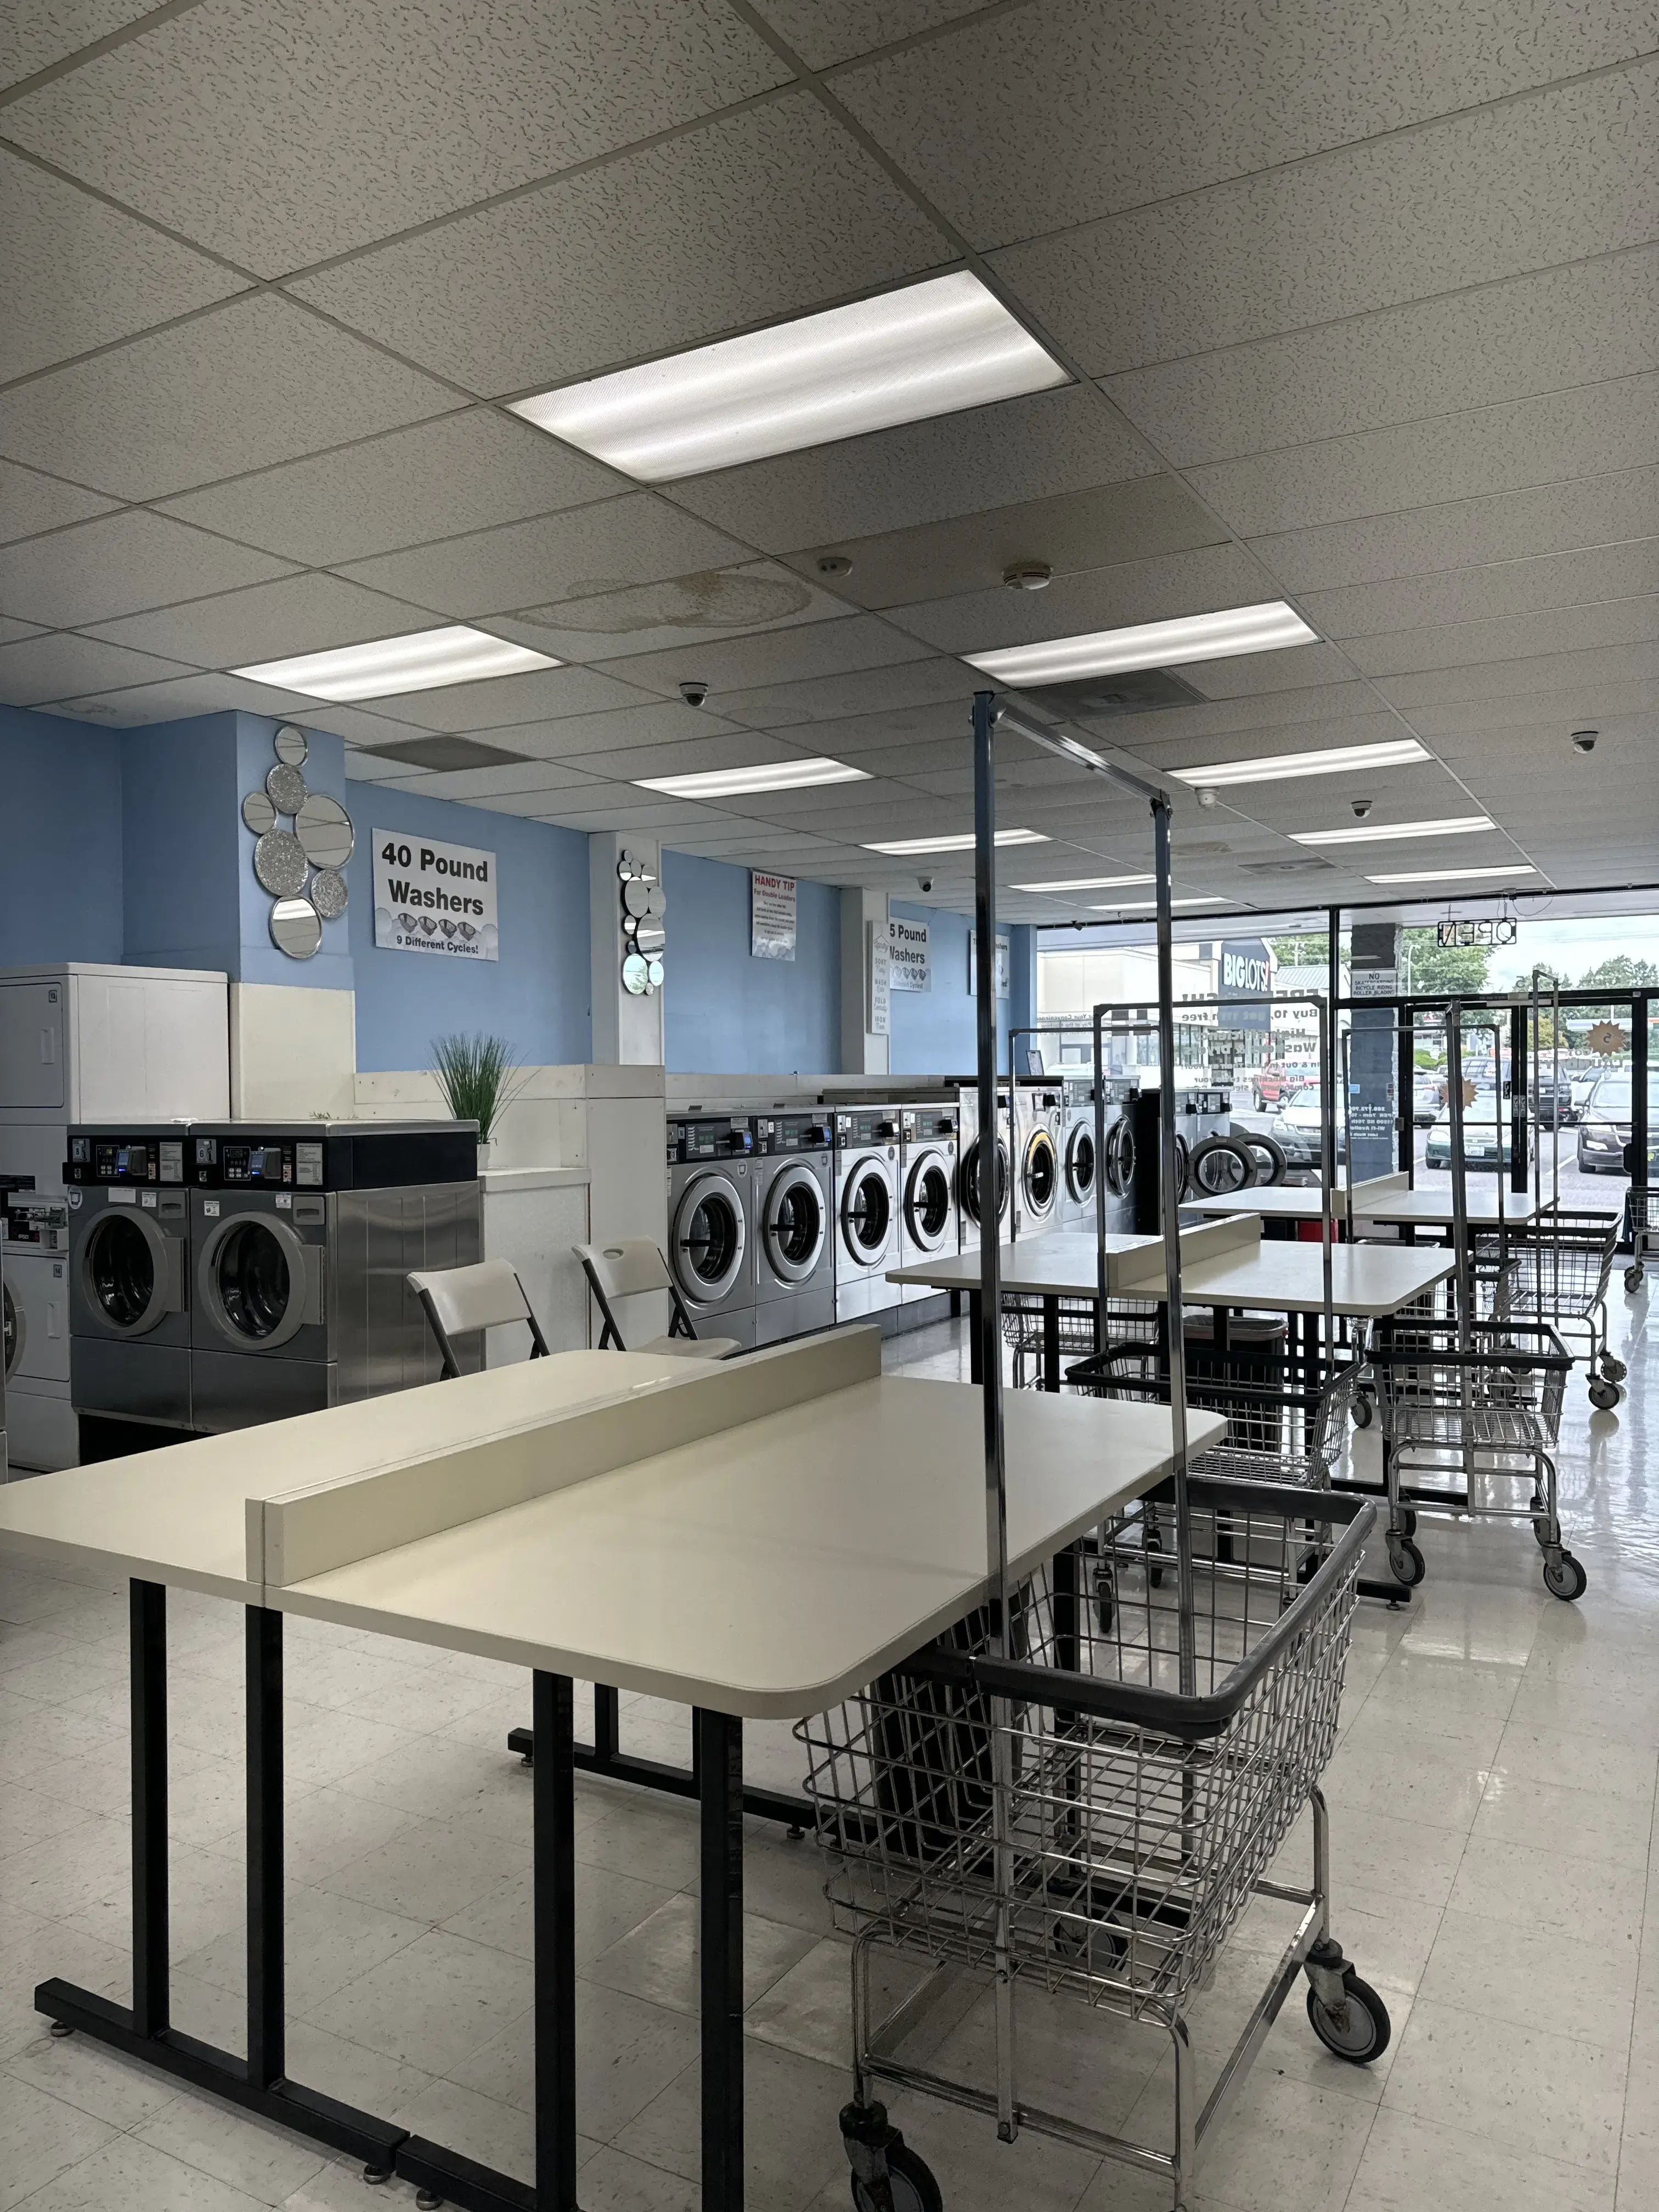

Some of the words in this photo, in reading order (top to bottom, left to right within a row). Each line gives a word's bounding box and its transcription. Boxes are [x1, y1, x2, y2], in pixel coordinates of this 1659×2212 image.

[382, 842, 411, 868] 40
[420, 848, 488, 882] Pound
[754, 874, 781, 889] HANDY
[783, 881, 795, 891] TIP
[388, 879, 483, 916] Washers
[762, 890, 778, 899] Double
[778, 893, 795, 902] Loaders
[898, 924, 927, 943] Pound
[397, 935, 402, 944] 9
[405, 936, 444, 950] Different
[447, 941, 479, 954] Cycles!
[874, 978, 887, 986] WASH
[76, 1147, 80, 1155] 8
[200, 1149, 204, 1158] 6
